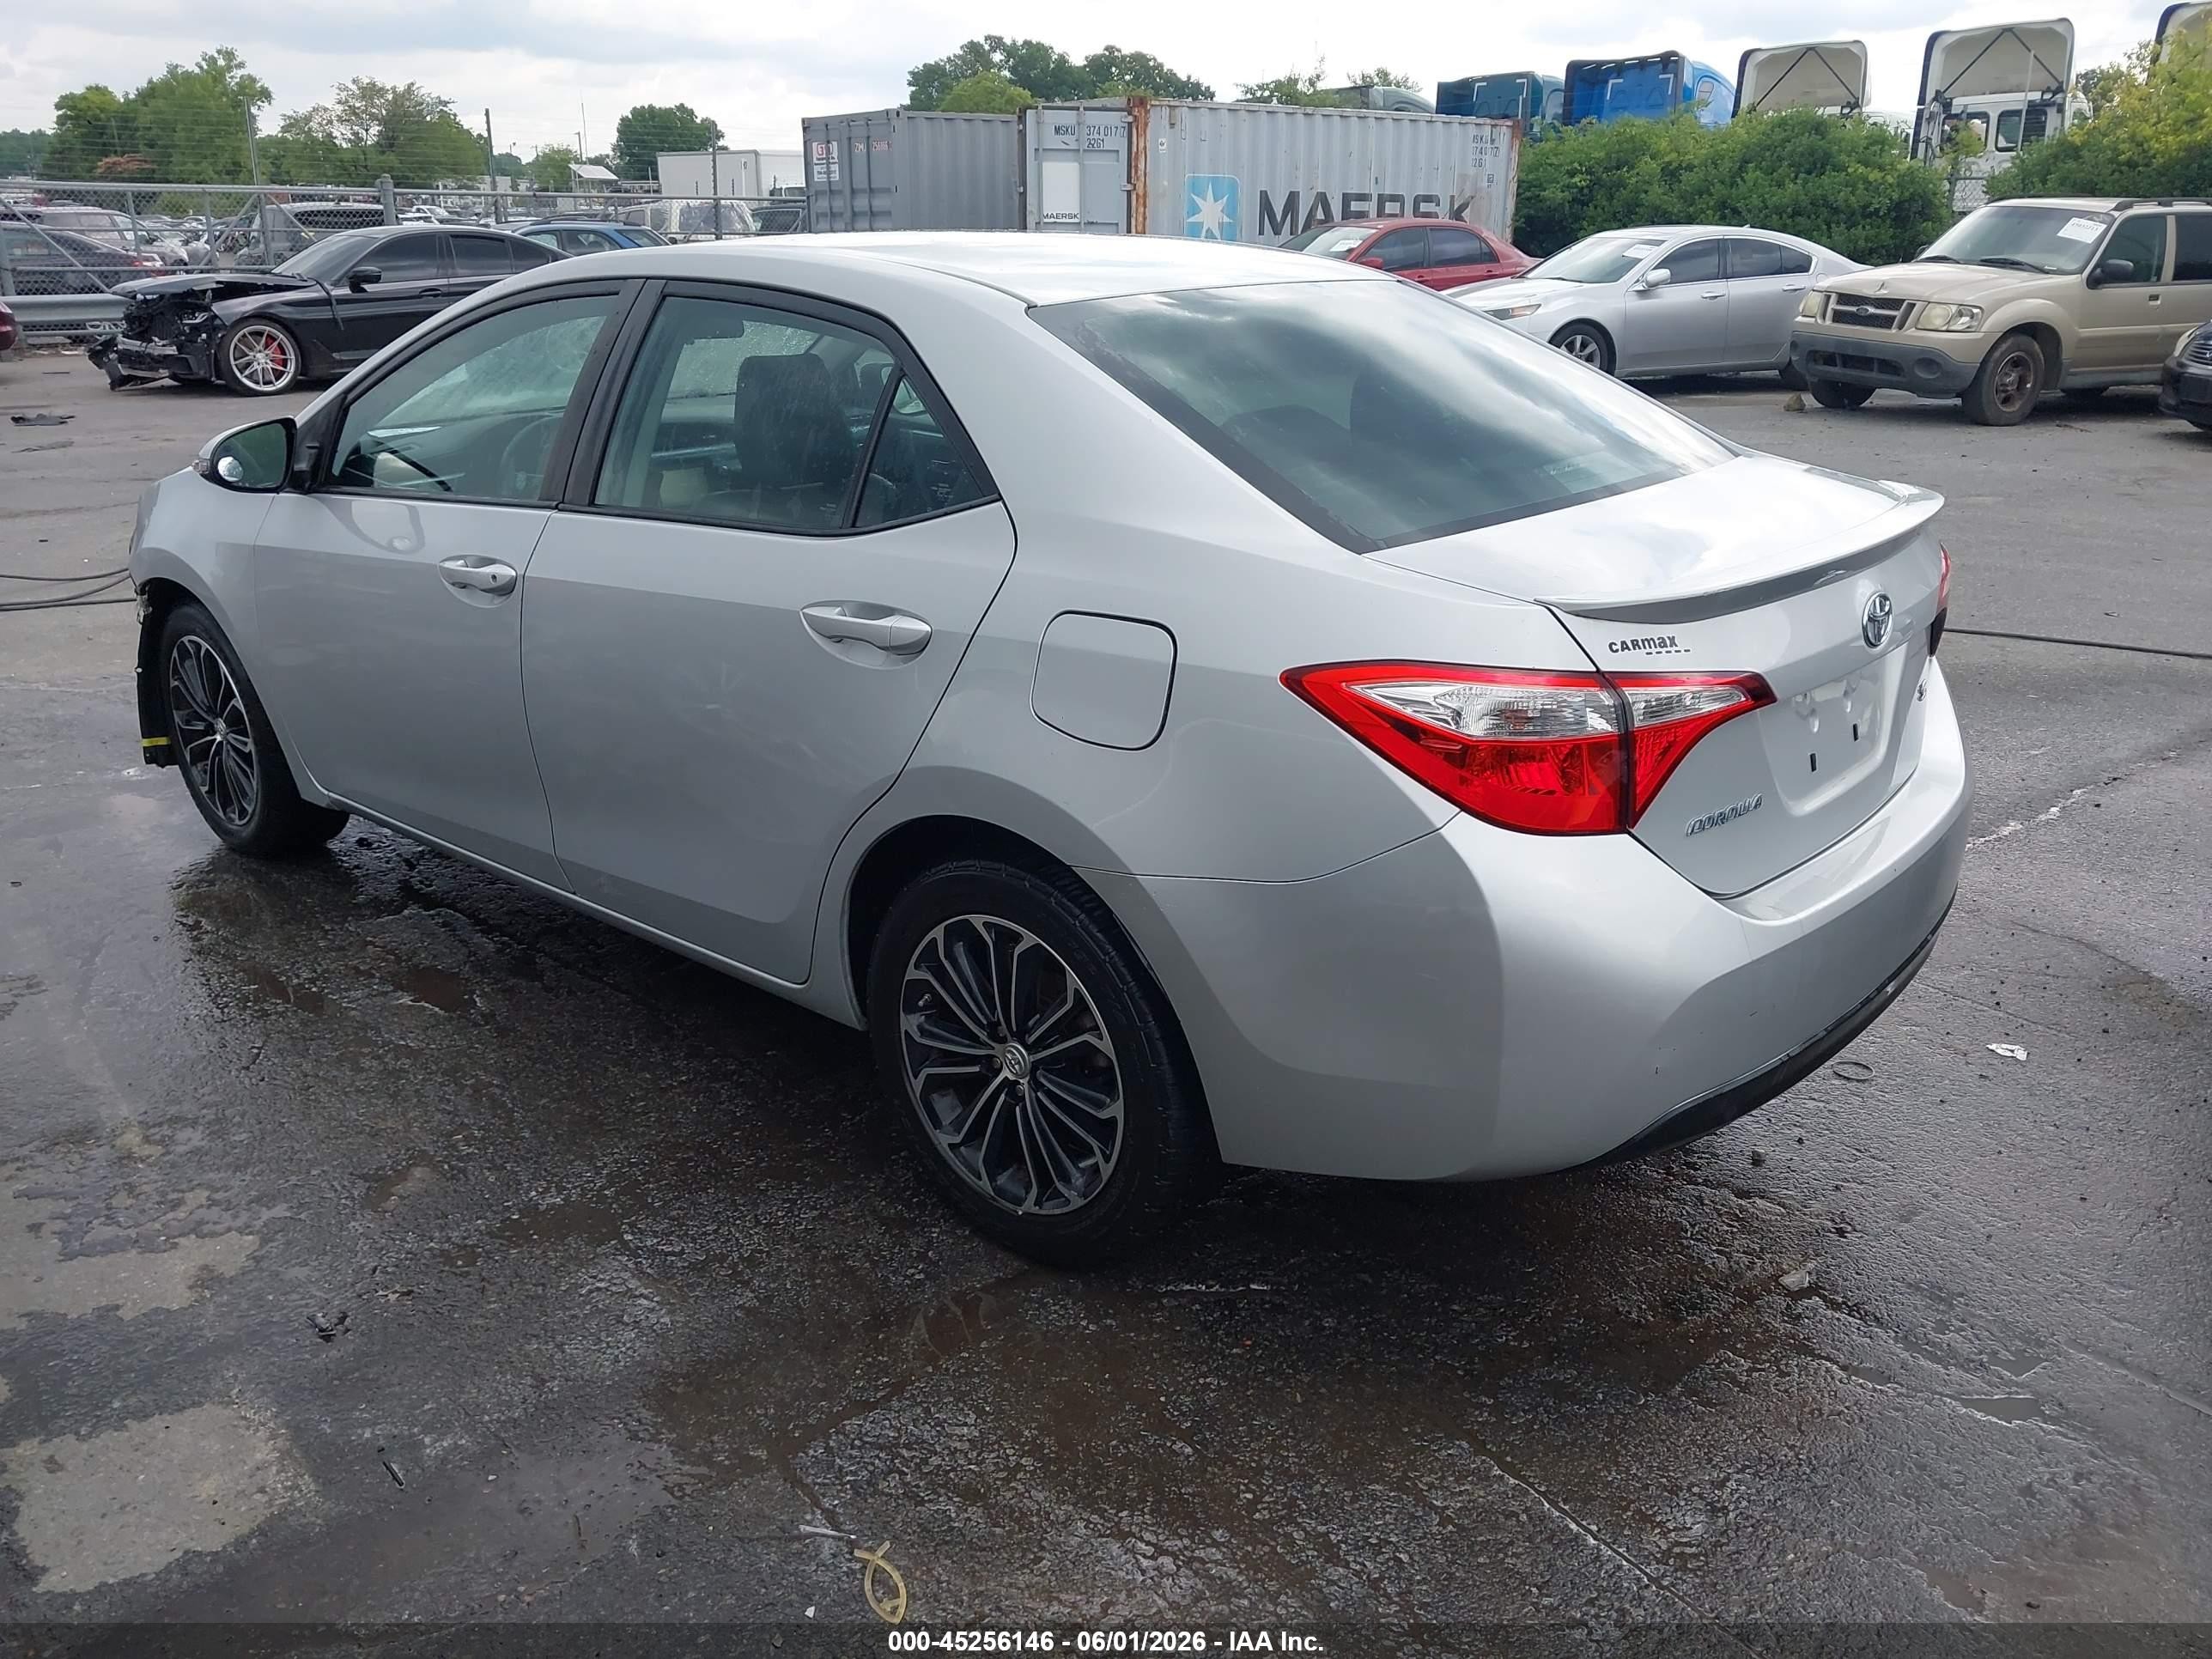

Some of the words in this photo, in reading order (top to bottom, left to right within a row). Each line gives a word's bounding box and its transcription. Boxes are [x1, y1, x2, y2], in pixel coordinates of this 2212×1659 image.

[1054, 125, 1076, 136] MSKU
[1086, 125, 1101, 137] 374
[1103, 125, 1119, 137] 017
[1686, 793, 1763, 837] COROLLA
